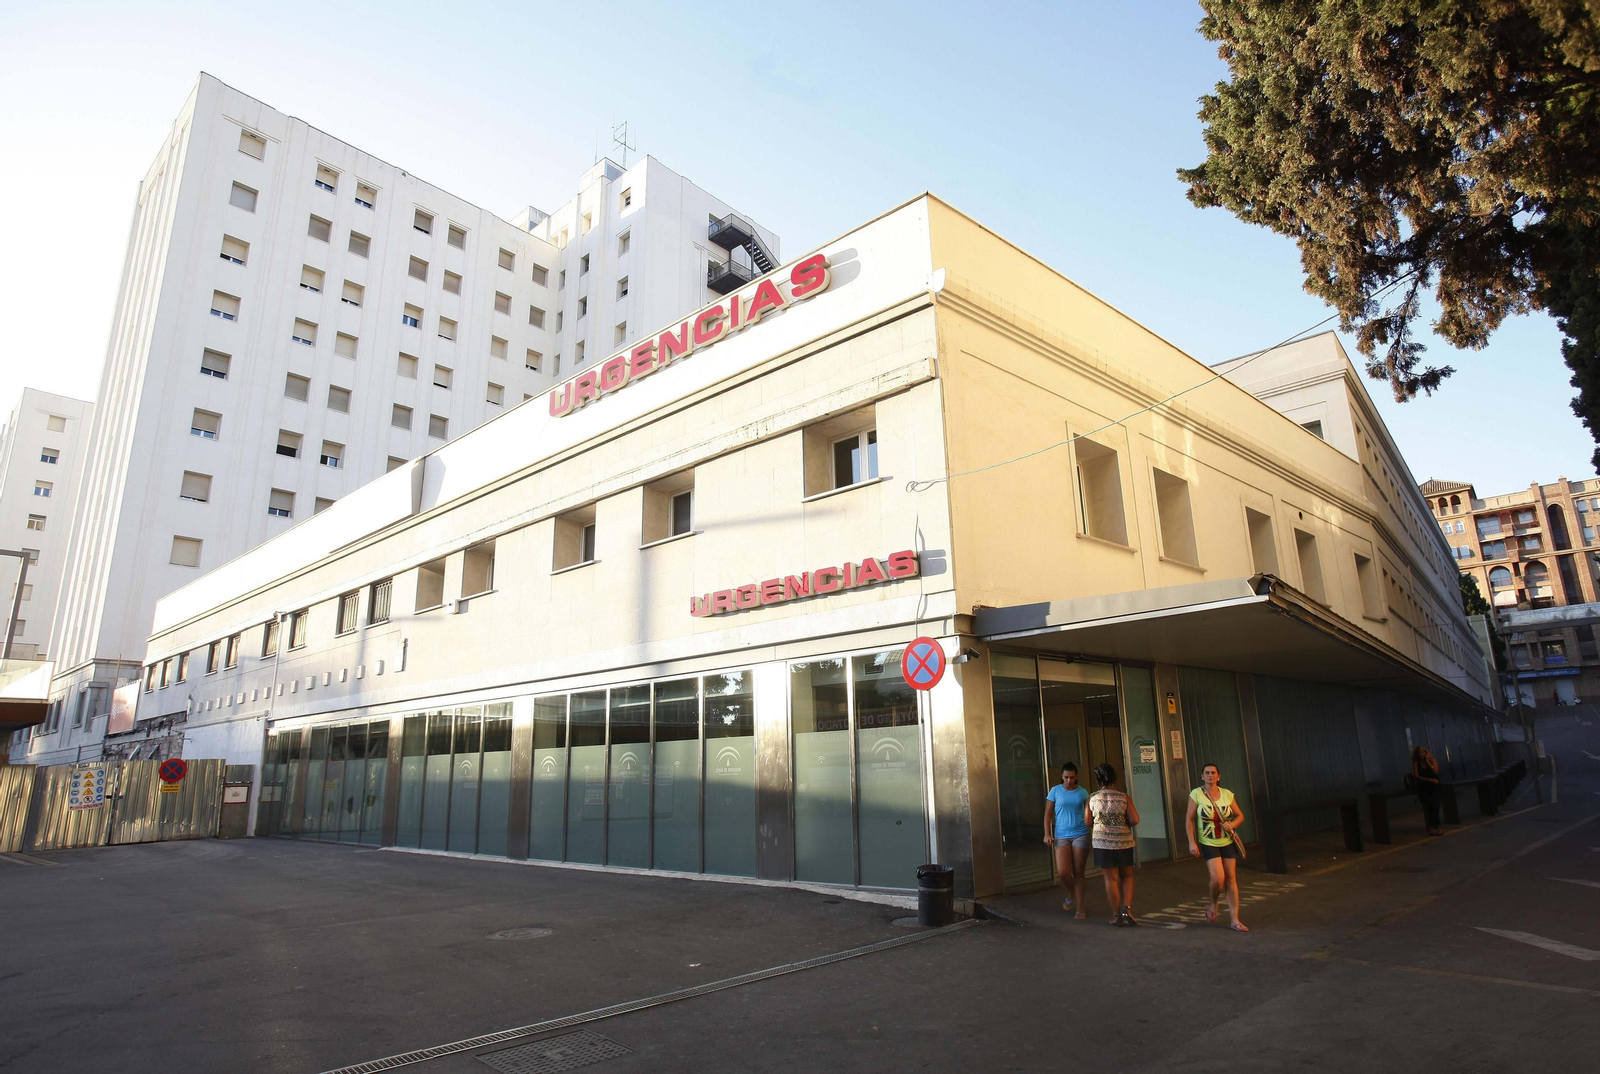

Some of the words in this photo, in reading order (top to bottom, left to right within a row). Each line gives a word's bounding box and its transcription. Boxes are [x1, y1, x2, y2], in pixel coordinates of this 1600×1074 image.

[548, 253, 831, 418] URGENCIAS
[690, 549, 920, 617] URGENCIAS
[1133, 765, 1152, 775] ENTRADA
